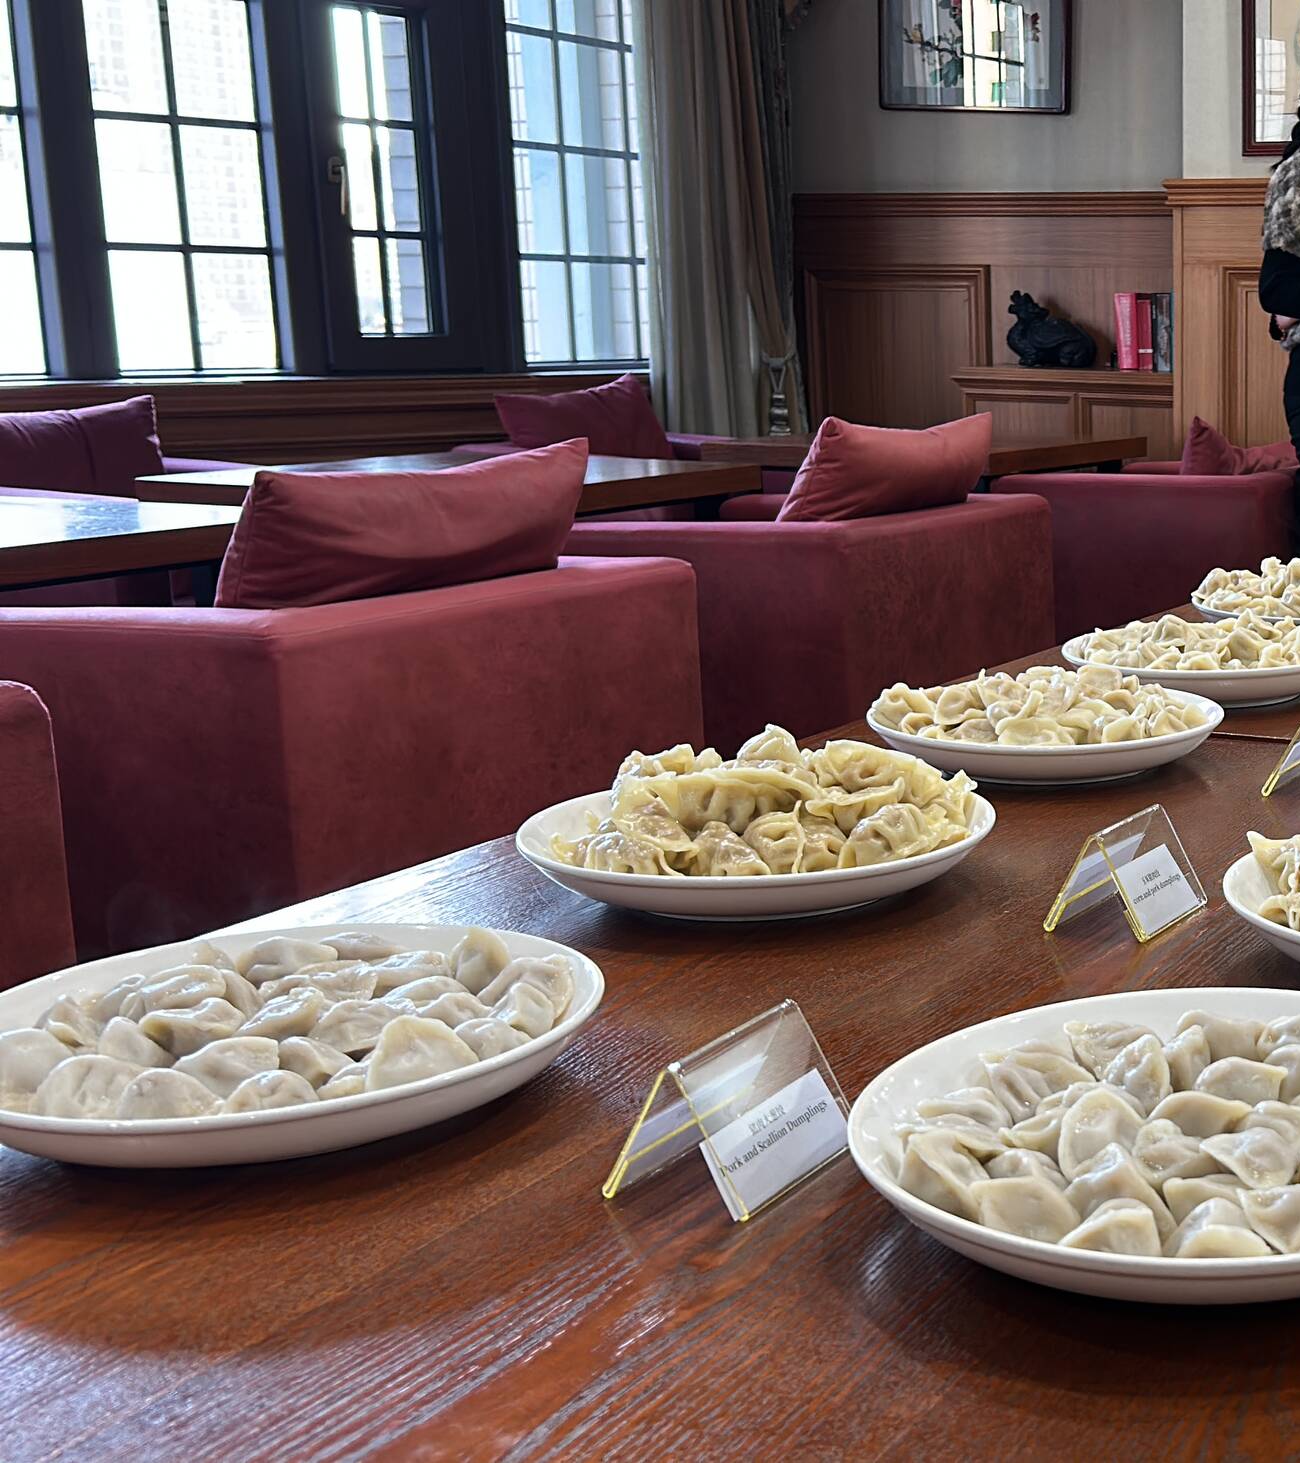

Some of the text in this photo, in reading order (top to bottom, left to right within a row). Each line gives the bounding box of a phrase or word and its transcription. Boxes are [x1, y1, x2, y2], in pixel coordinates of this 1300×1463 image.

[719, 1099, 828, 1177] Pork and Scallion Dumplings
